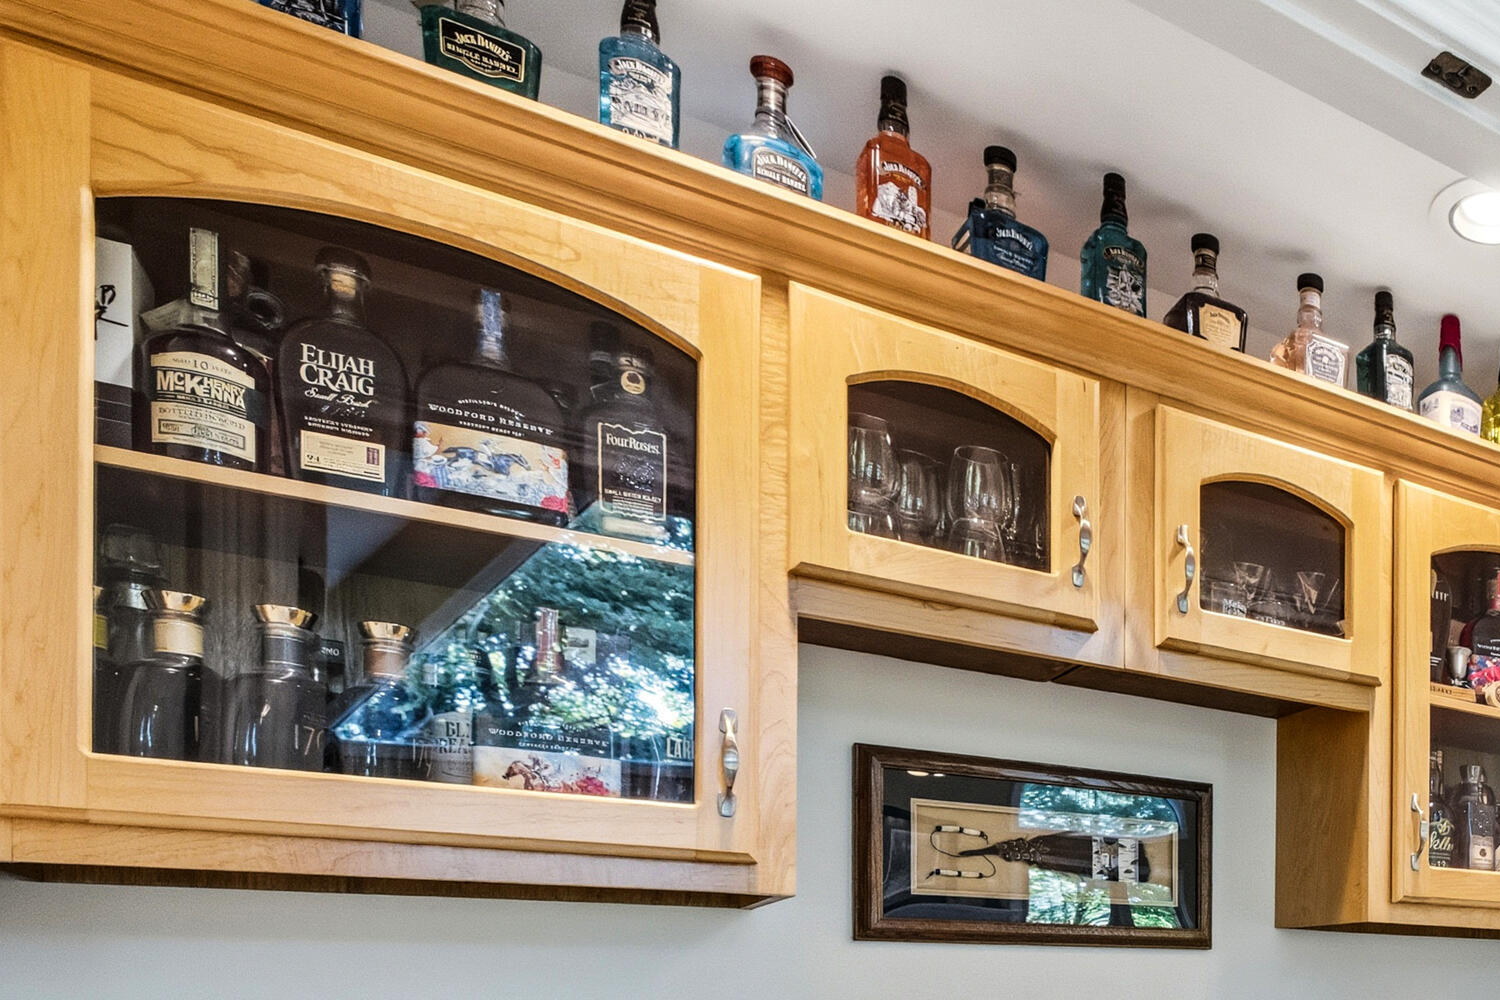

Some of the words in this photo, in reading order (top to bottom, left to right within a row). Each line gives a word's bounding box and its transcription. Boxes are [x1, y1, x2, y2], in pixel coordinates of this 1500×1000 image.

[193, 359, 209, 371] 10
[300, 342, 376, 378] ELIJAH
[300, 363, 375, 396] CRAIG
[427, 402, 496, 422] WOODFORD
[499, 416, 555, 436] RESERVE
[605, 433, 628, 447] Four
[488, 726, 554, 741] WOODFORD
[557, 734, 610, 749] RESERVE
